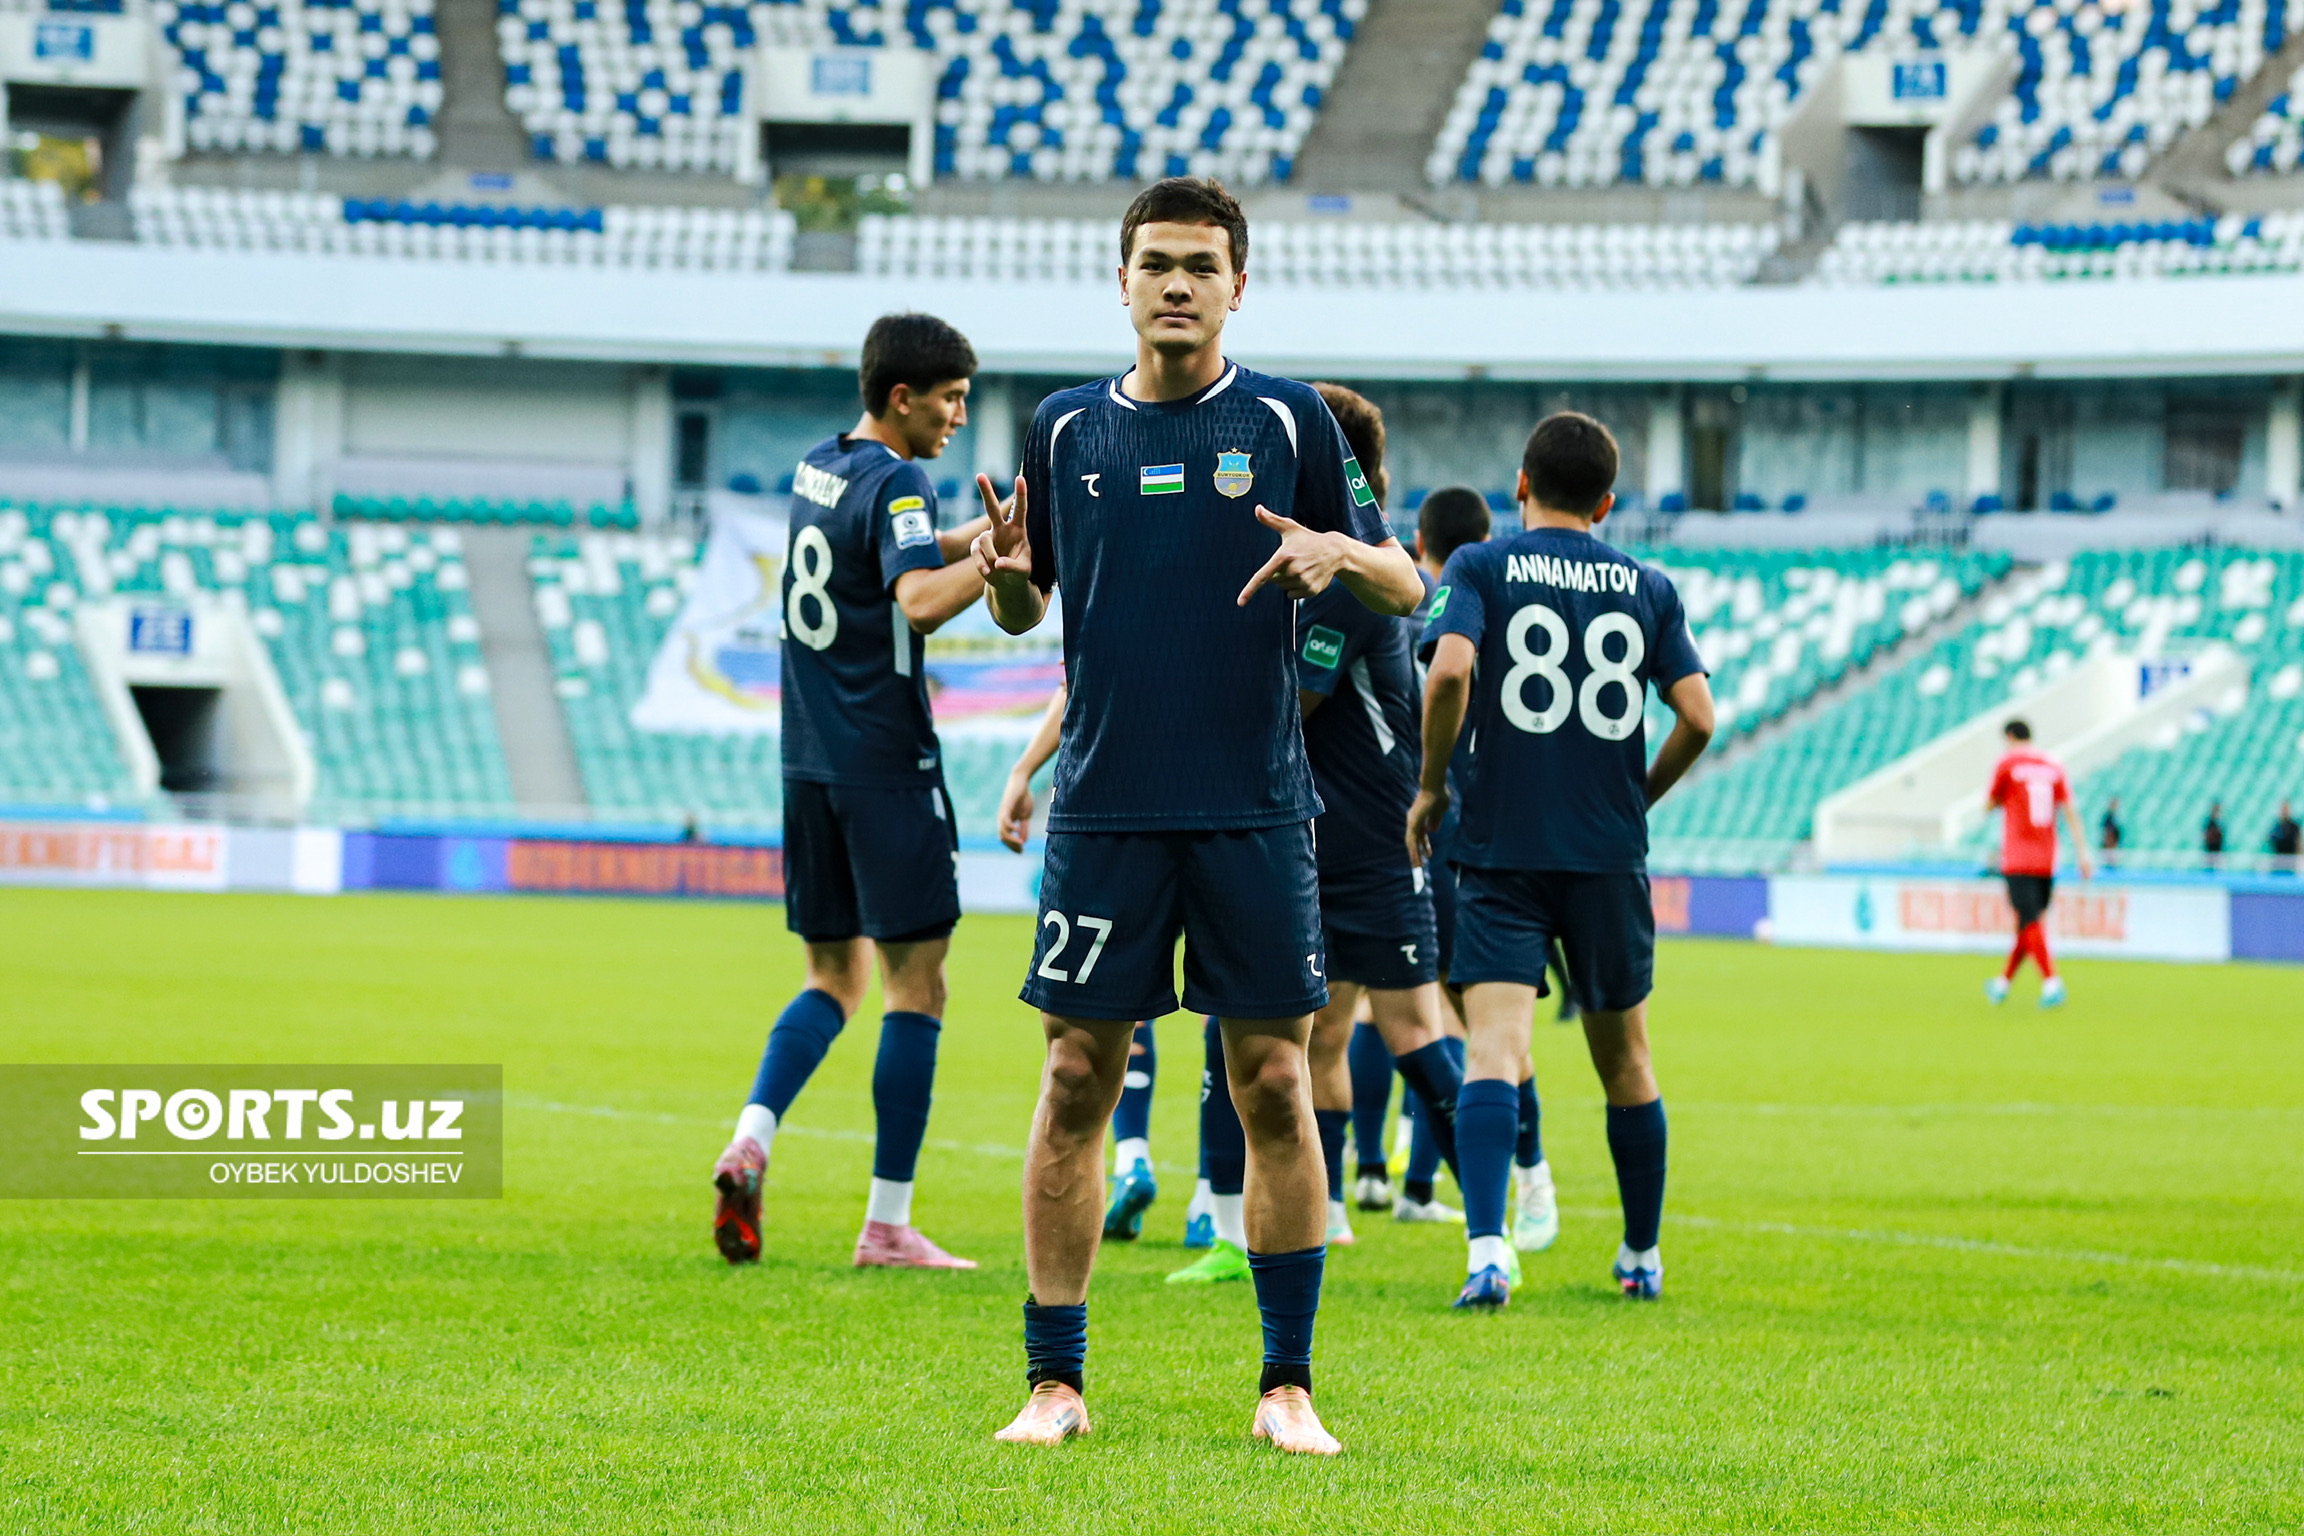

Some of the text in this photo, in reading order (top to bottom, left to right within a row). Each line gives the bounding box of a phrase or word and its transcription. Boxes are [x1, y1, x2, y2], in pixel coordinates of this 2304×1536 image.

[1506, 554, 1638, 596] ANNAMATOV
[1500, 603, 1646, 742] 88
[1037, 909, 1113, 985] 27
